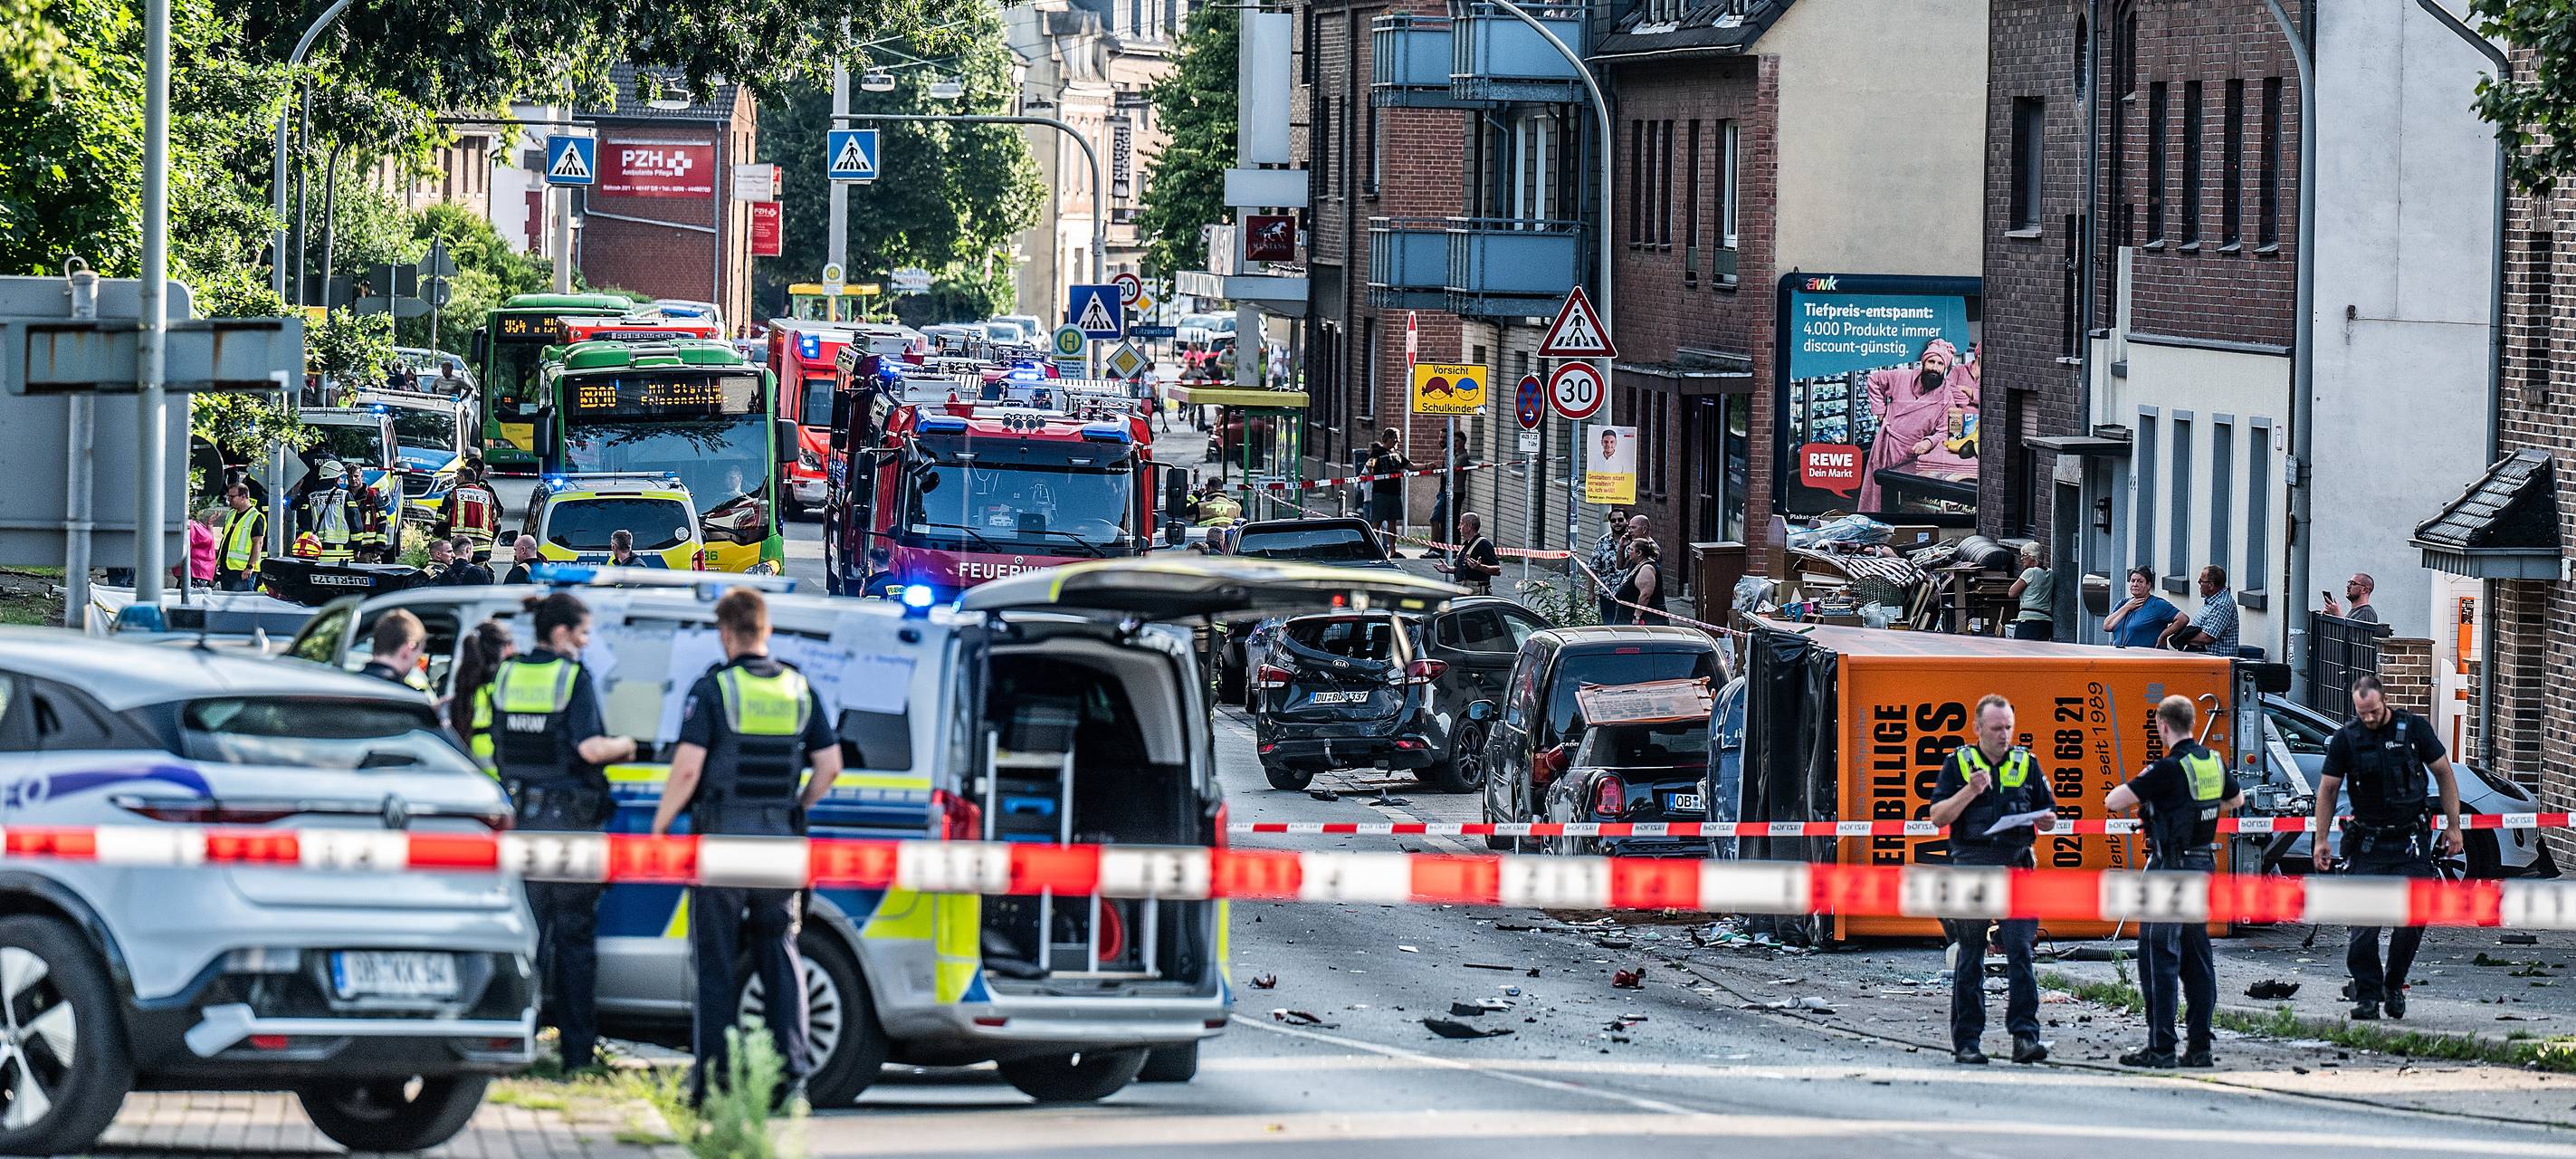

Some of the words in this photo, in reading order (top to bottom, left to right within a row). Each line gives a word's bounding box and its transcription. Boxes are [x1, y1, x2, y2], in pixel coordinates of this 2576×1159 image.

[622, 149, 663, 168] PZH
[1807, 275, 1839, 291] awk
[1803, 302, 1933, 321] Tiefpreis-entspannt:
[1803, 321, 1840, 336] 4.000
[1844, 323, 1898, 337] Produkte
[1902, 324, 1942, 337] immer
[1803, 339, 1909, 357] discount-günstig.
[1433, 366, 1469, 376] Vorsicht
[1560, 378, 1592, 404] 30
[1422, 402, 1476, 413] Schulkinder
[1808, 453, 1854, 467] REWE
[1808, 467, 1827, 478] Dein
[1827, 468, 1853, 478] Markt
[959, 562, 1043, 580] FEUERW
[355, 576, 369, 586] DU
[1316, 693, 1327, 703] DU
[1349, 692, 1368, 702] 337
[2055, 696, 2085, 723] 21
[2087, 681, 2107, 736] 1989
[2054, 729, 2084, 761] 68
[1872, 704, 1907, 820] BILLIGE
[2094, 740, 2112, 775] seit
[2054, 767, 2084, 799] 68
[1675, 795, 1693, 808] OB
[2200, 807, 2218, 821] NRW
